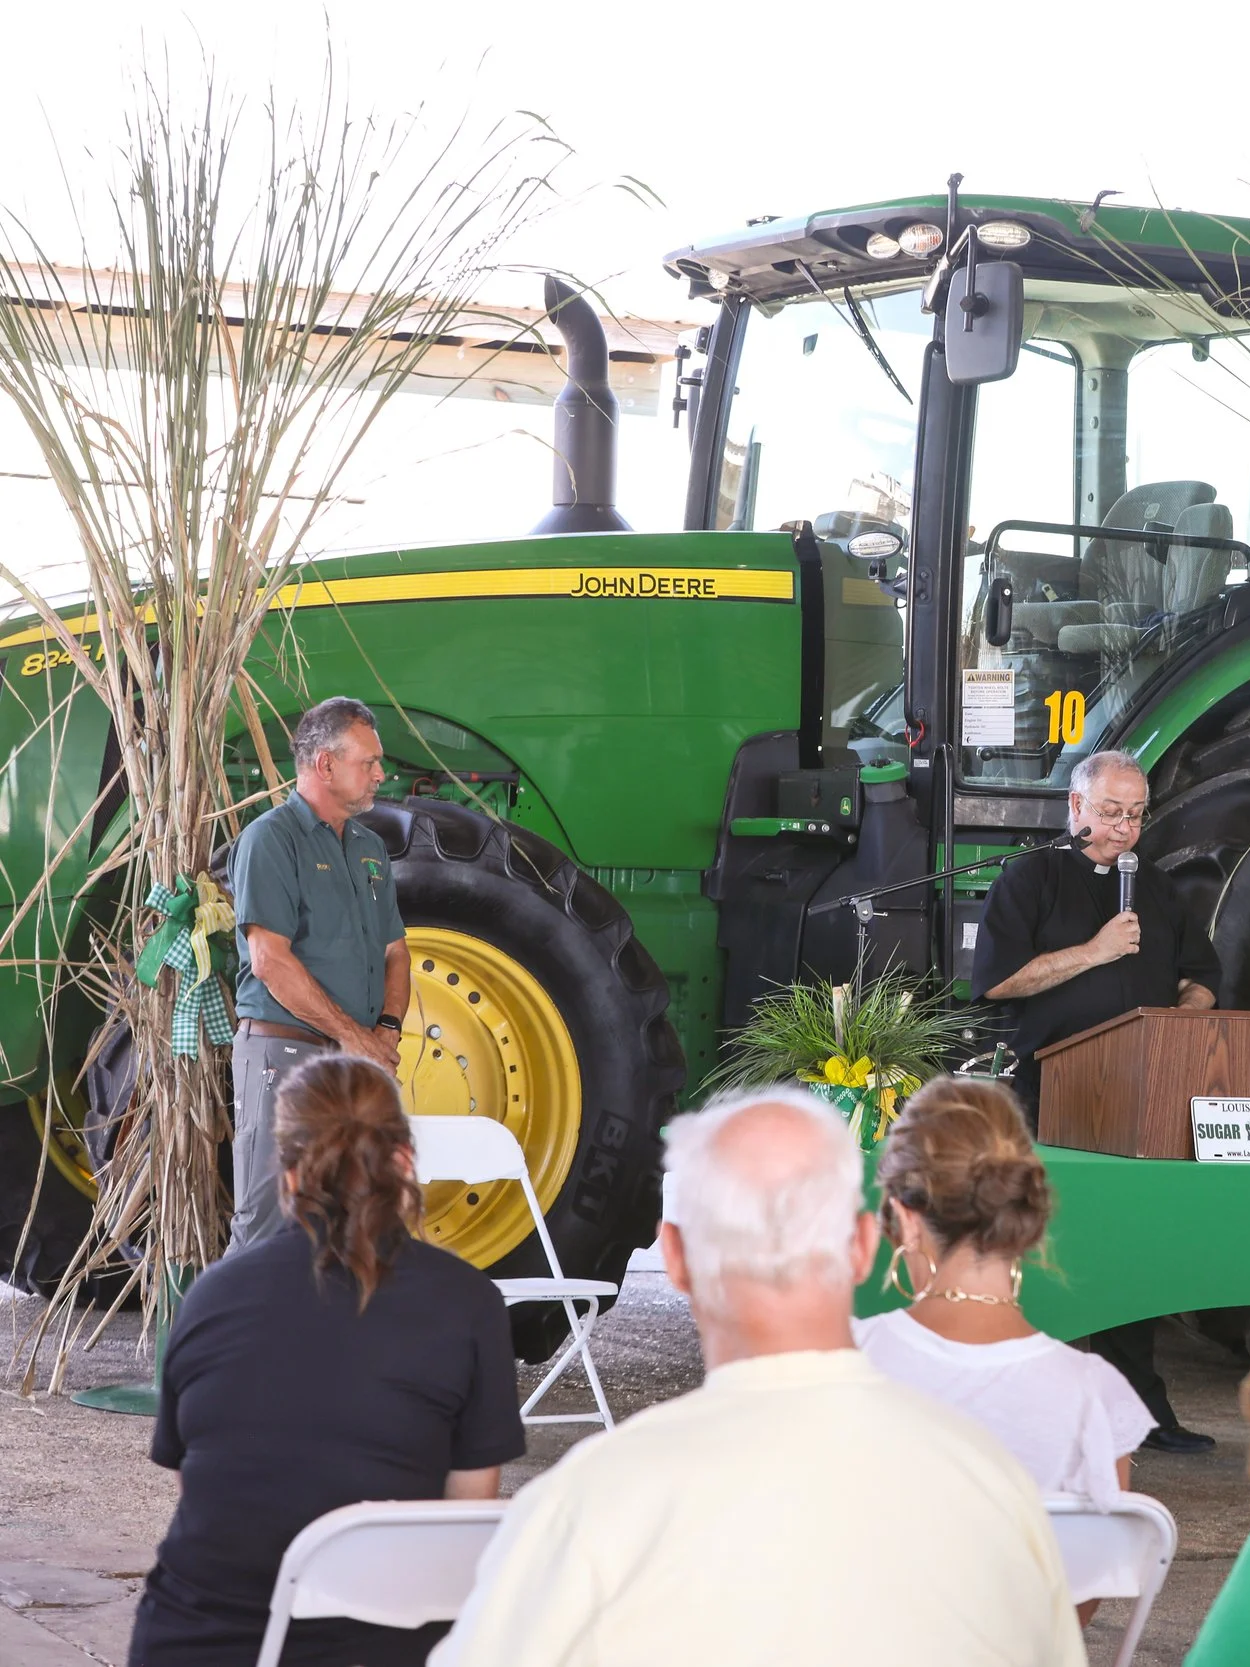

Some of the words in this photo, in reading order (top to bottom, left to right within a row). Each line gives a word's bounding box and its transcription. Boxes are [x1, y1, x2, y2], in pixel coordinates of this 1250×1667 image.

[571, 573, 634, 594] JOHN
[639, 574, 716, 595] DEERE
[974, 673, 1010, 682] WARNING
[1044, 690, 1086, 745] 10
[1197, 1123, 1241, 1139] SUGAR
